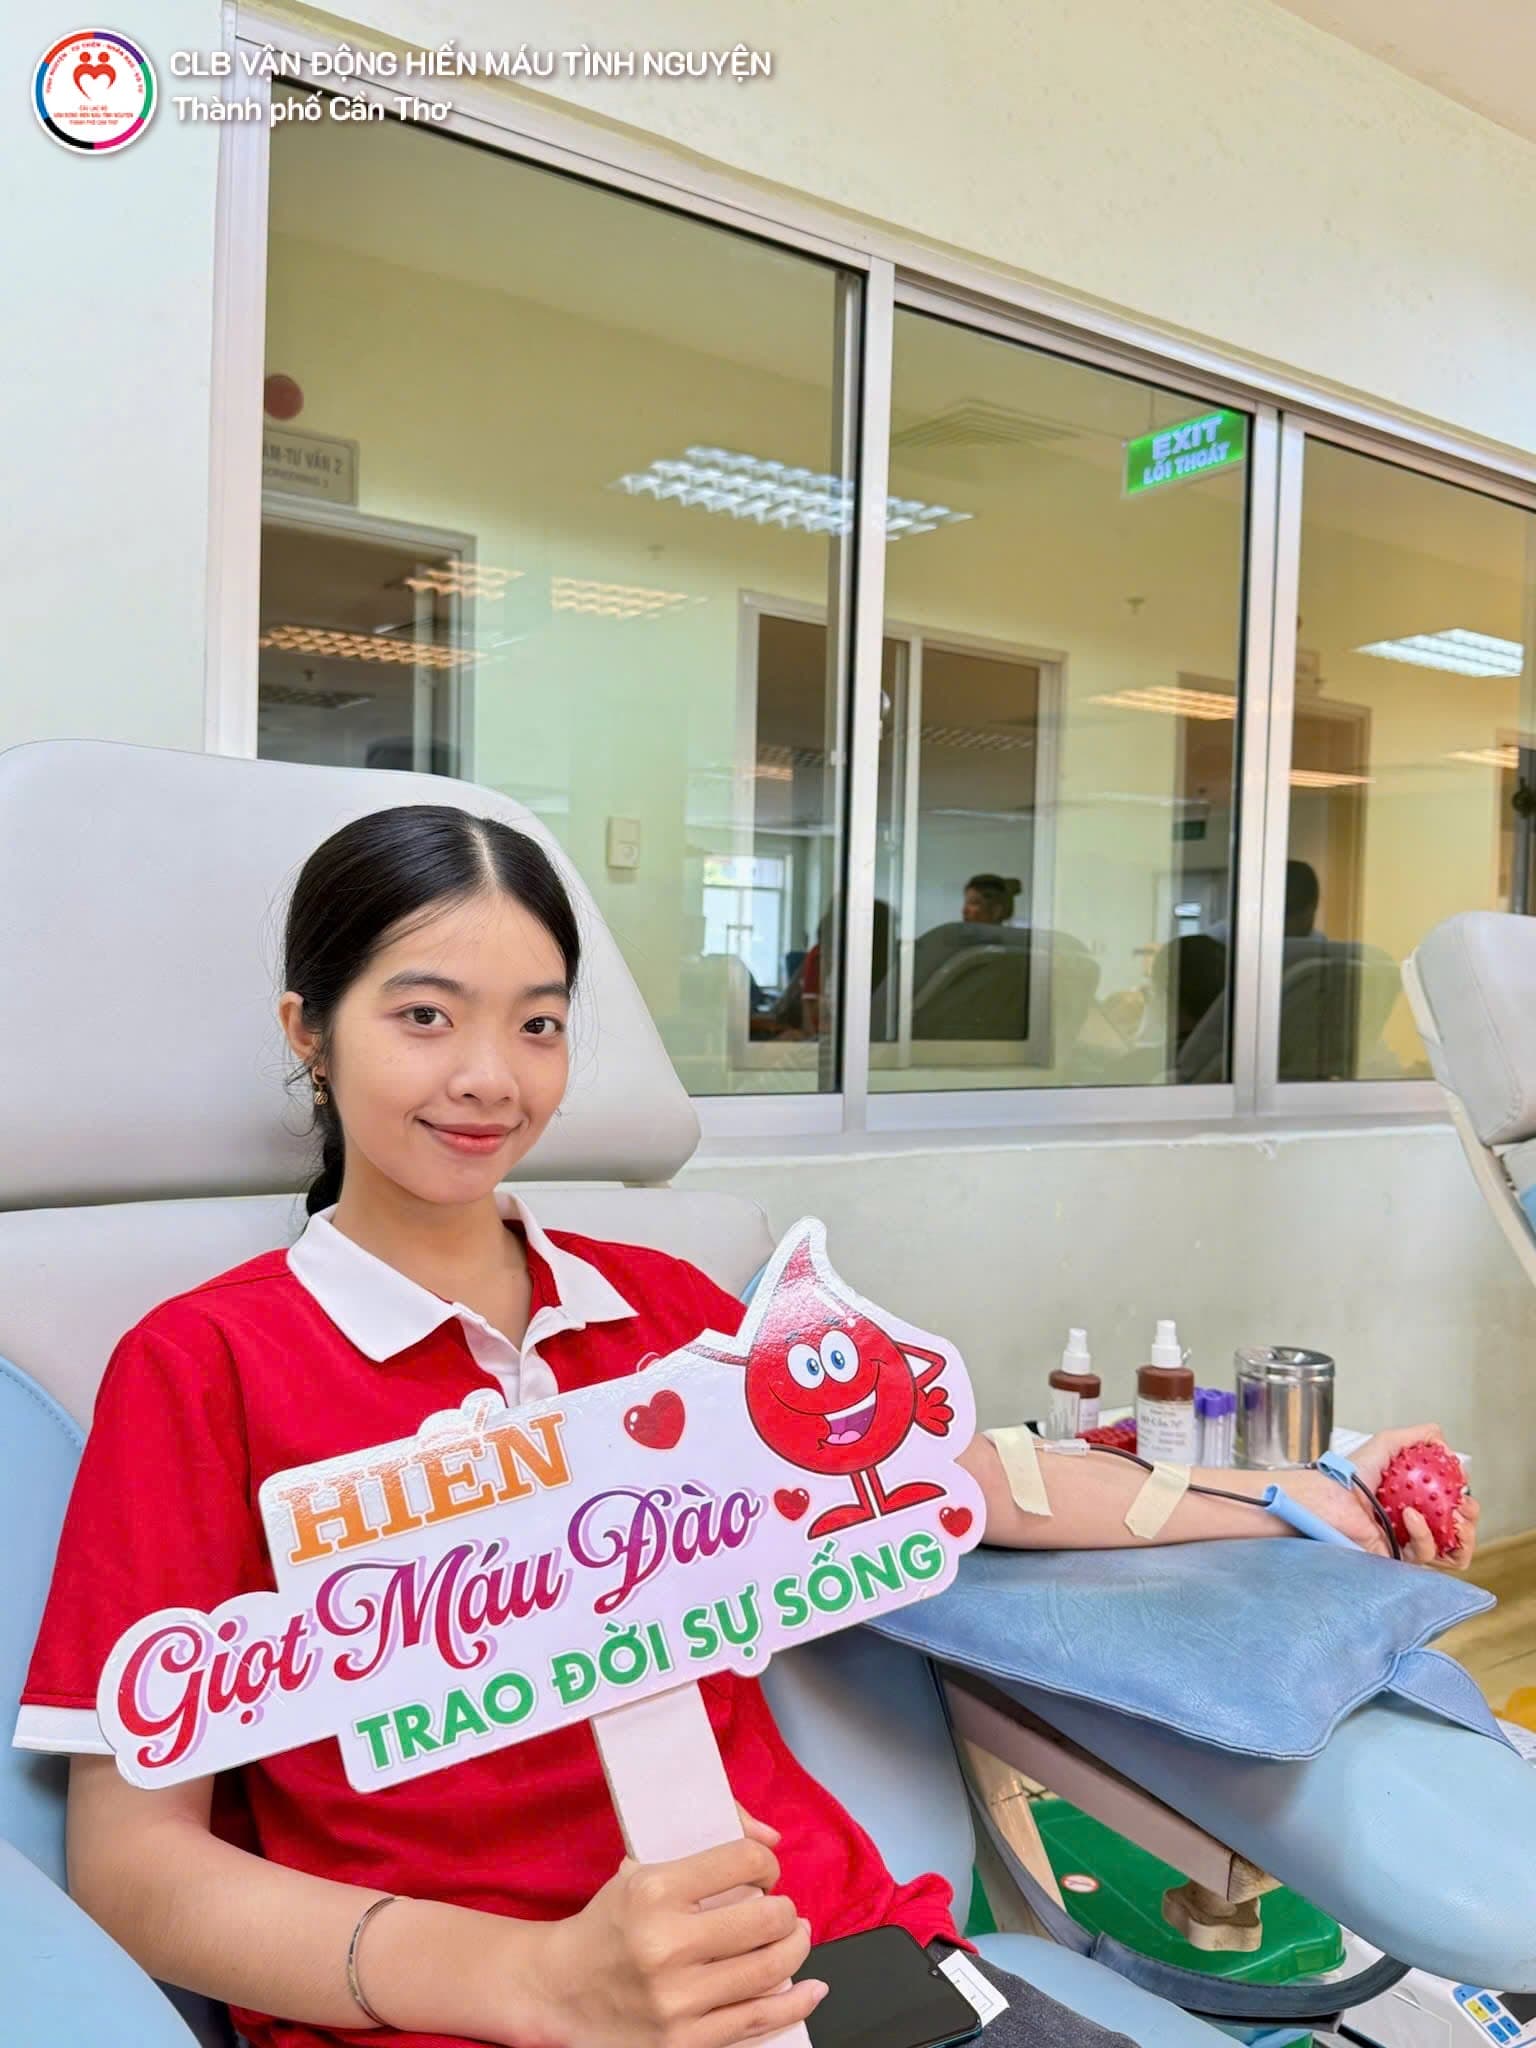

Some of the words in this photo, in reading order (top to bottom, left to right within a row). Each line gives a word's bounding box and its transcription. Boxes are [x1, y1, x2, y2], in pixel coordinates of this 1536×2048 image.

[1143, 459, 1172, 485] LỐI
[1174, 441, 1231, 474] THOÁT
[1152, 416, 1223, 460] EXIT
[278, 1402, 570, 1563] HIẾN
[117, 1614, 315, 1768] Giọt
[316, 1542, 565, 1681] Máu
[567, 1484, 762, 1614] Đào
[356, 1672, 534, 1769] TRAO
[551, 1621, 672, 1706] ĐỜI
[682, 1586, 763, 1659] SỰ
[773, 1532, 943, 1627] SỐNG
